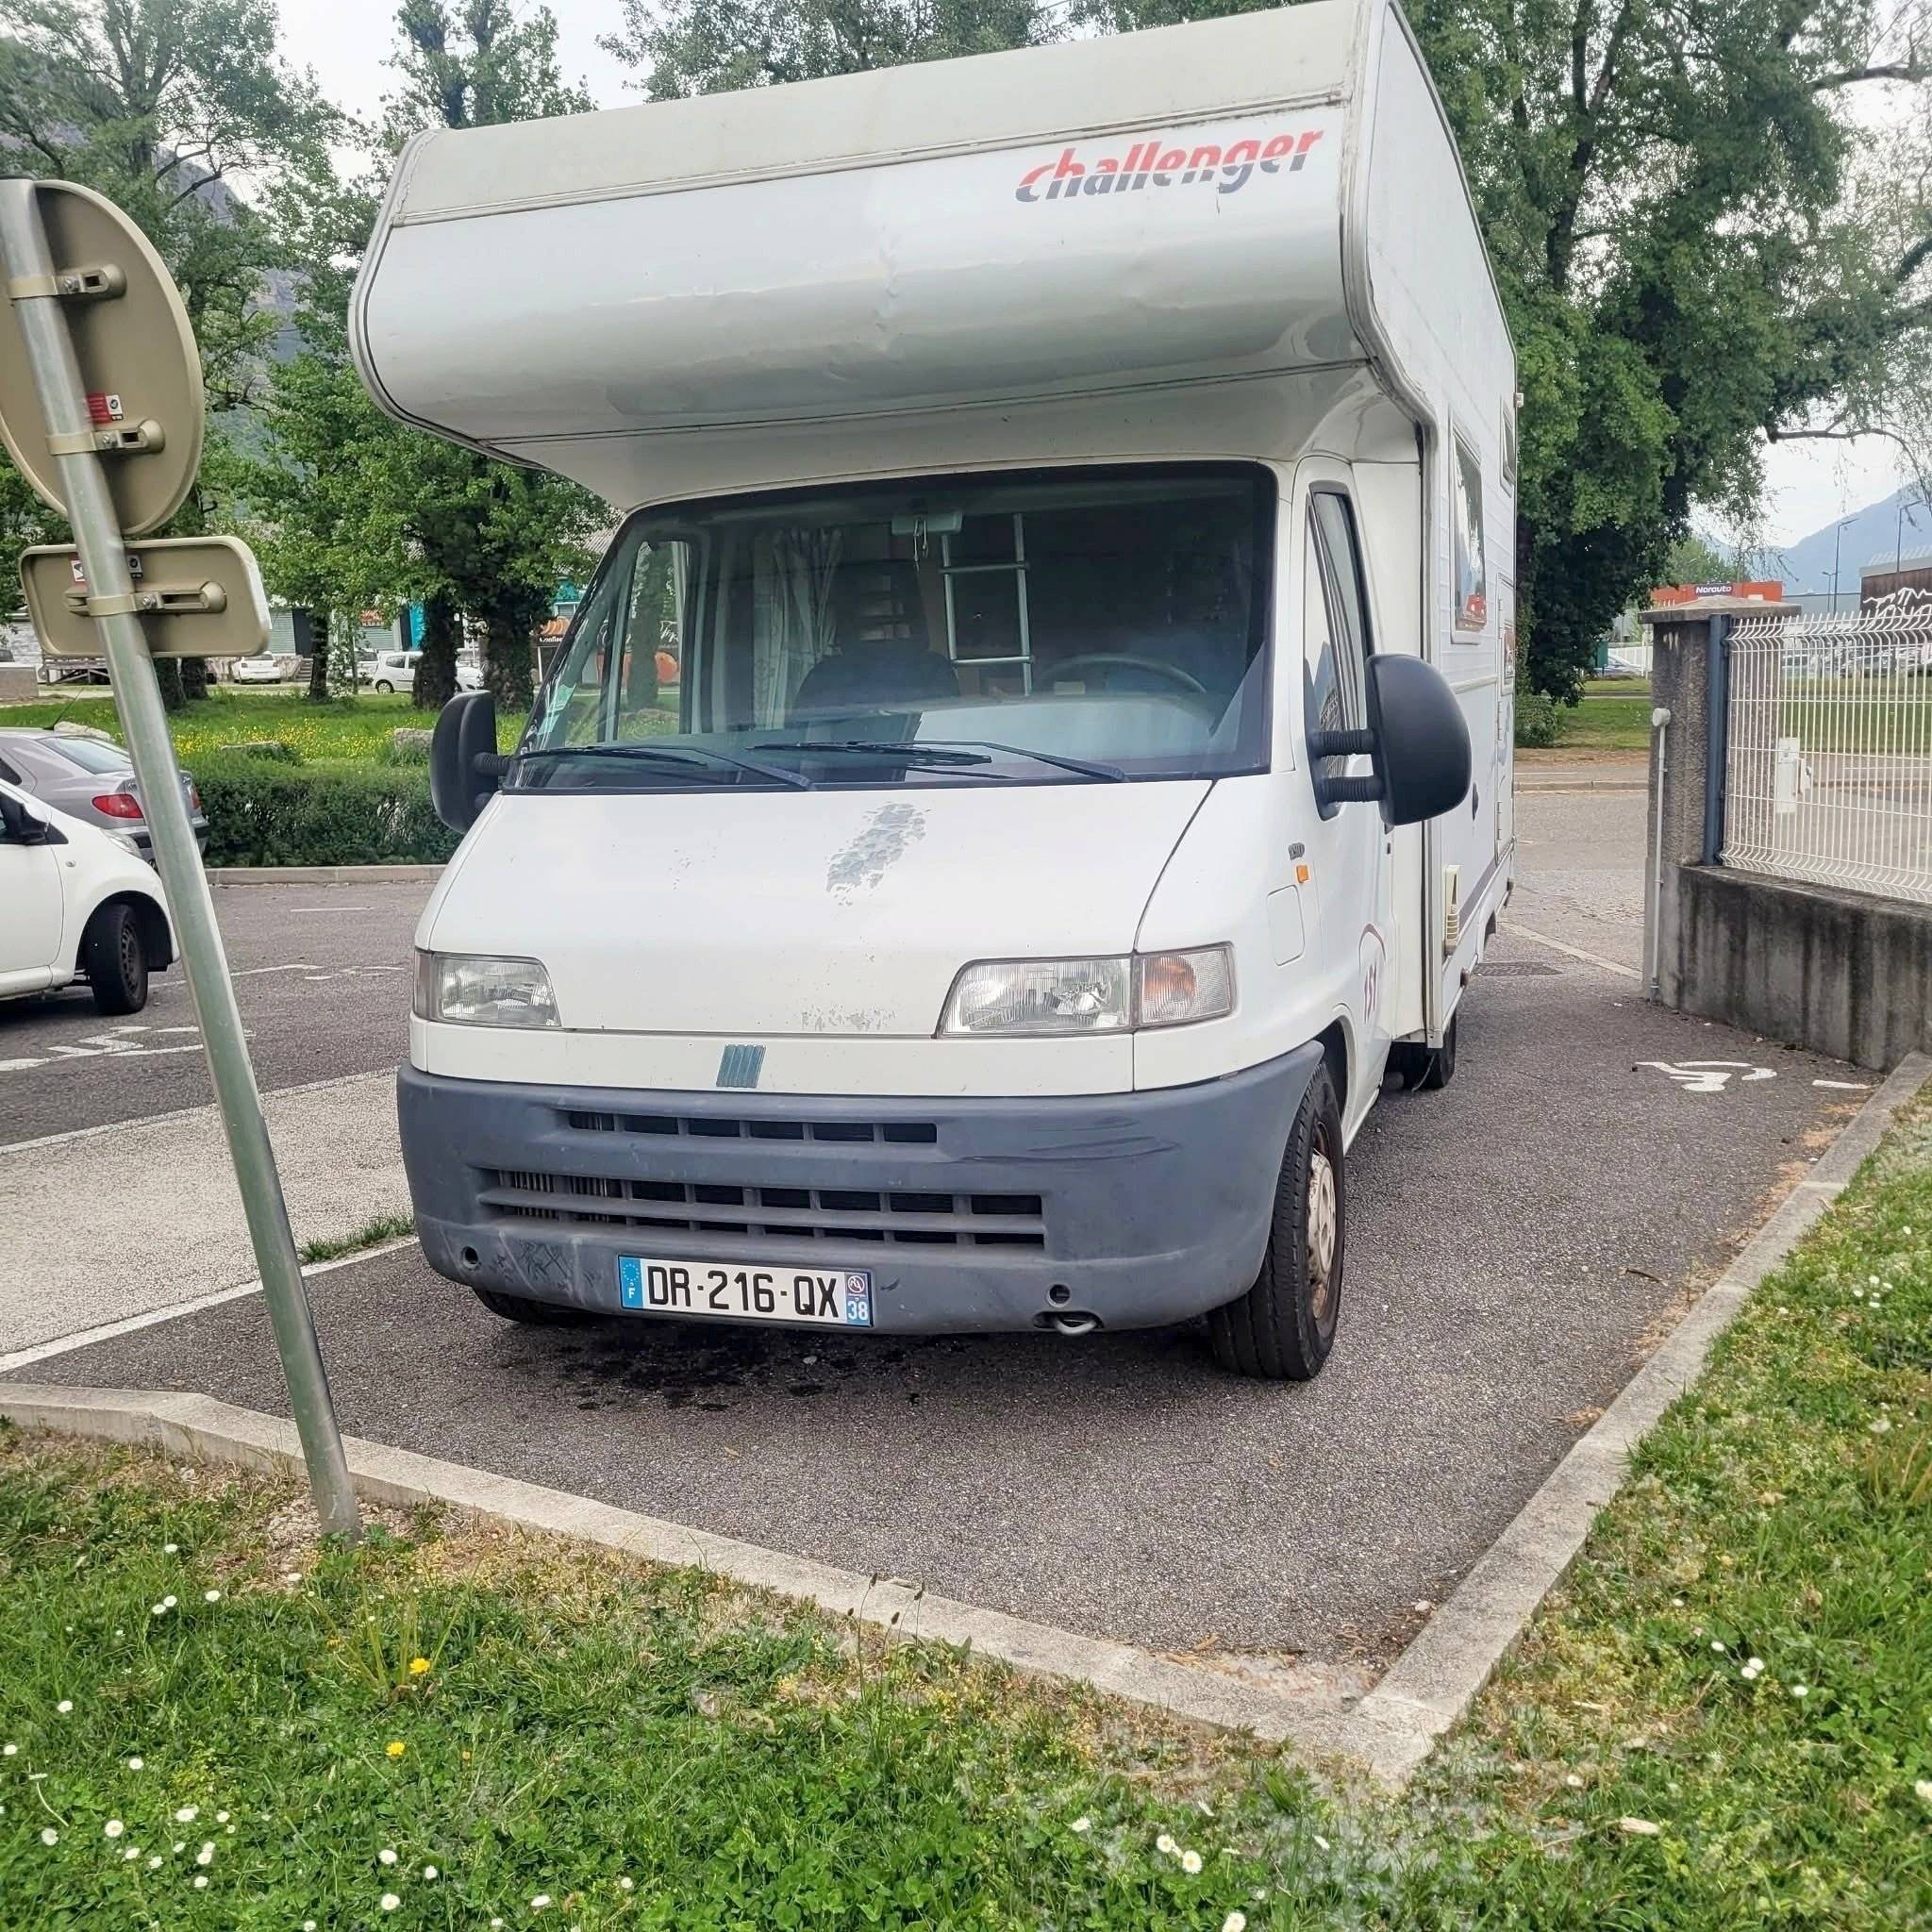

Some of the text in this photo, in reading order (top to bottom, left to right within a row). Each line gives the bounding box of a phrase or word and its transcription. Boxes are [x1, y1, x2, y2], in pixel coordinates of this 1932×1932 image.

[1695, 586, 1732, 594] Norauto
[628, 1265, 869, 1321] F DR-216-QX 38
